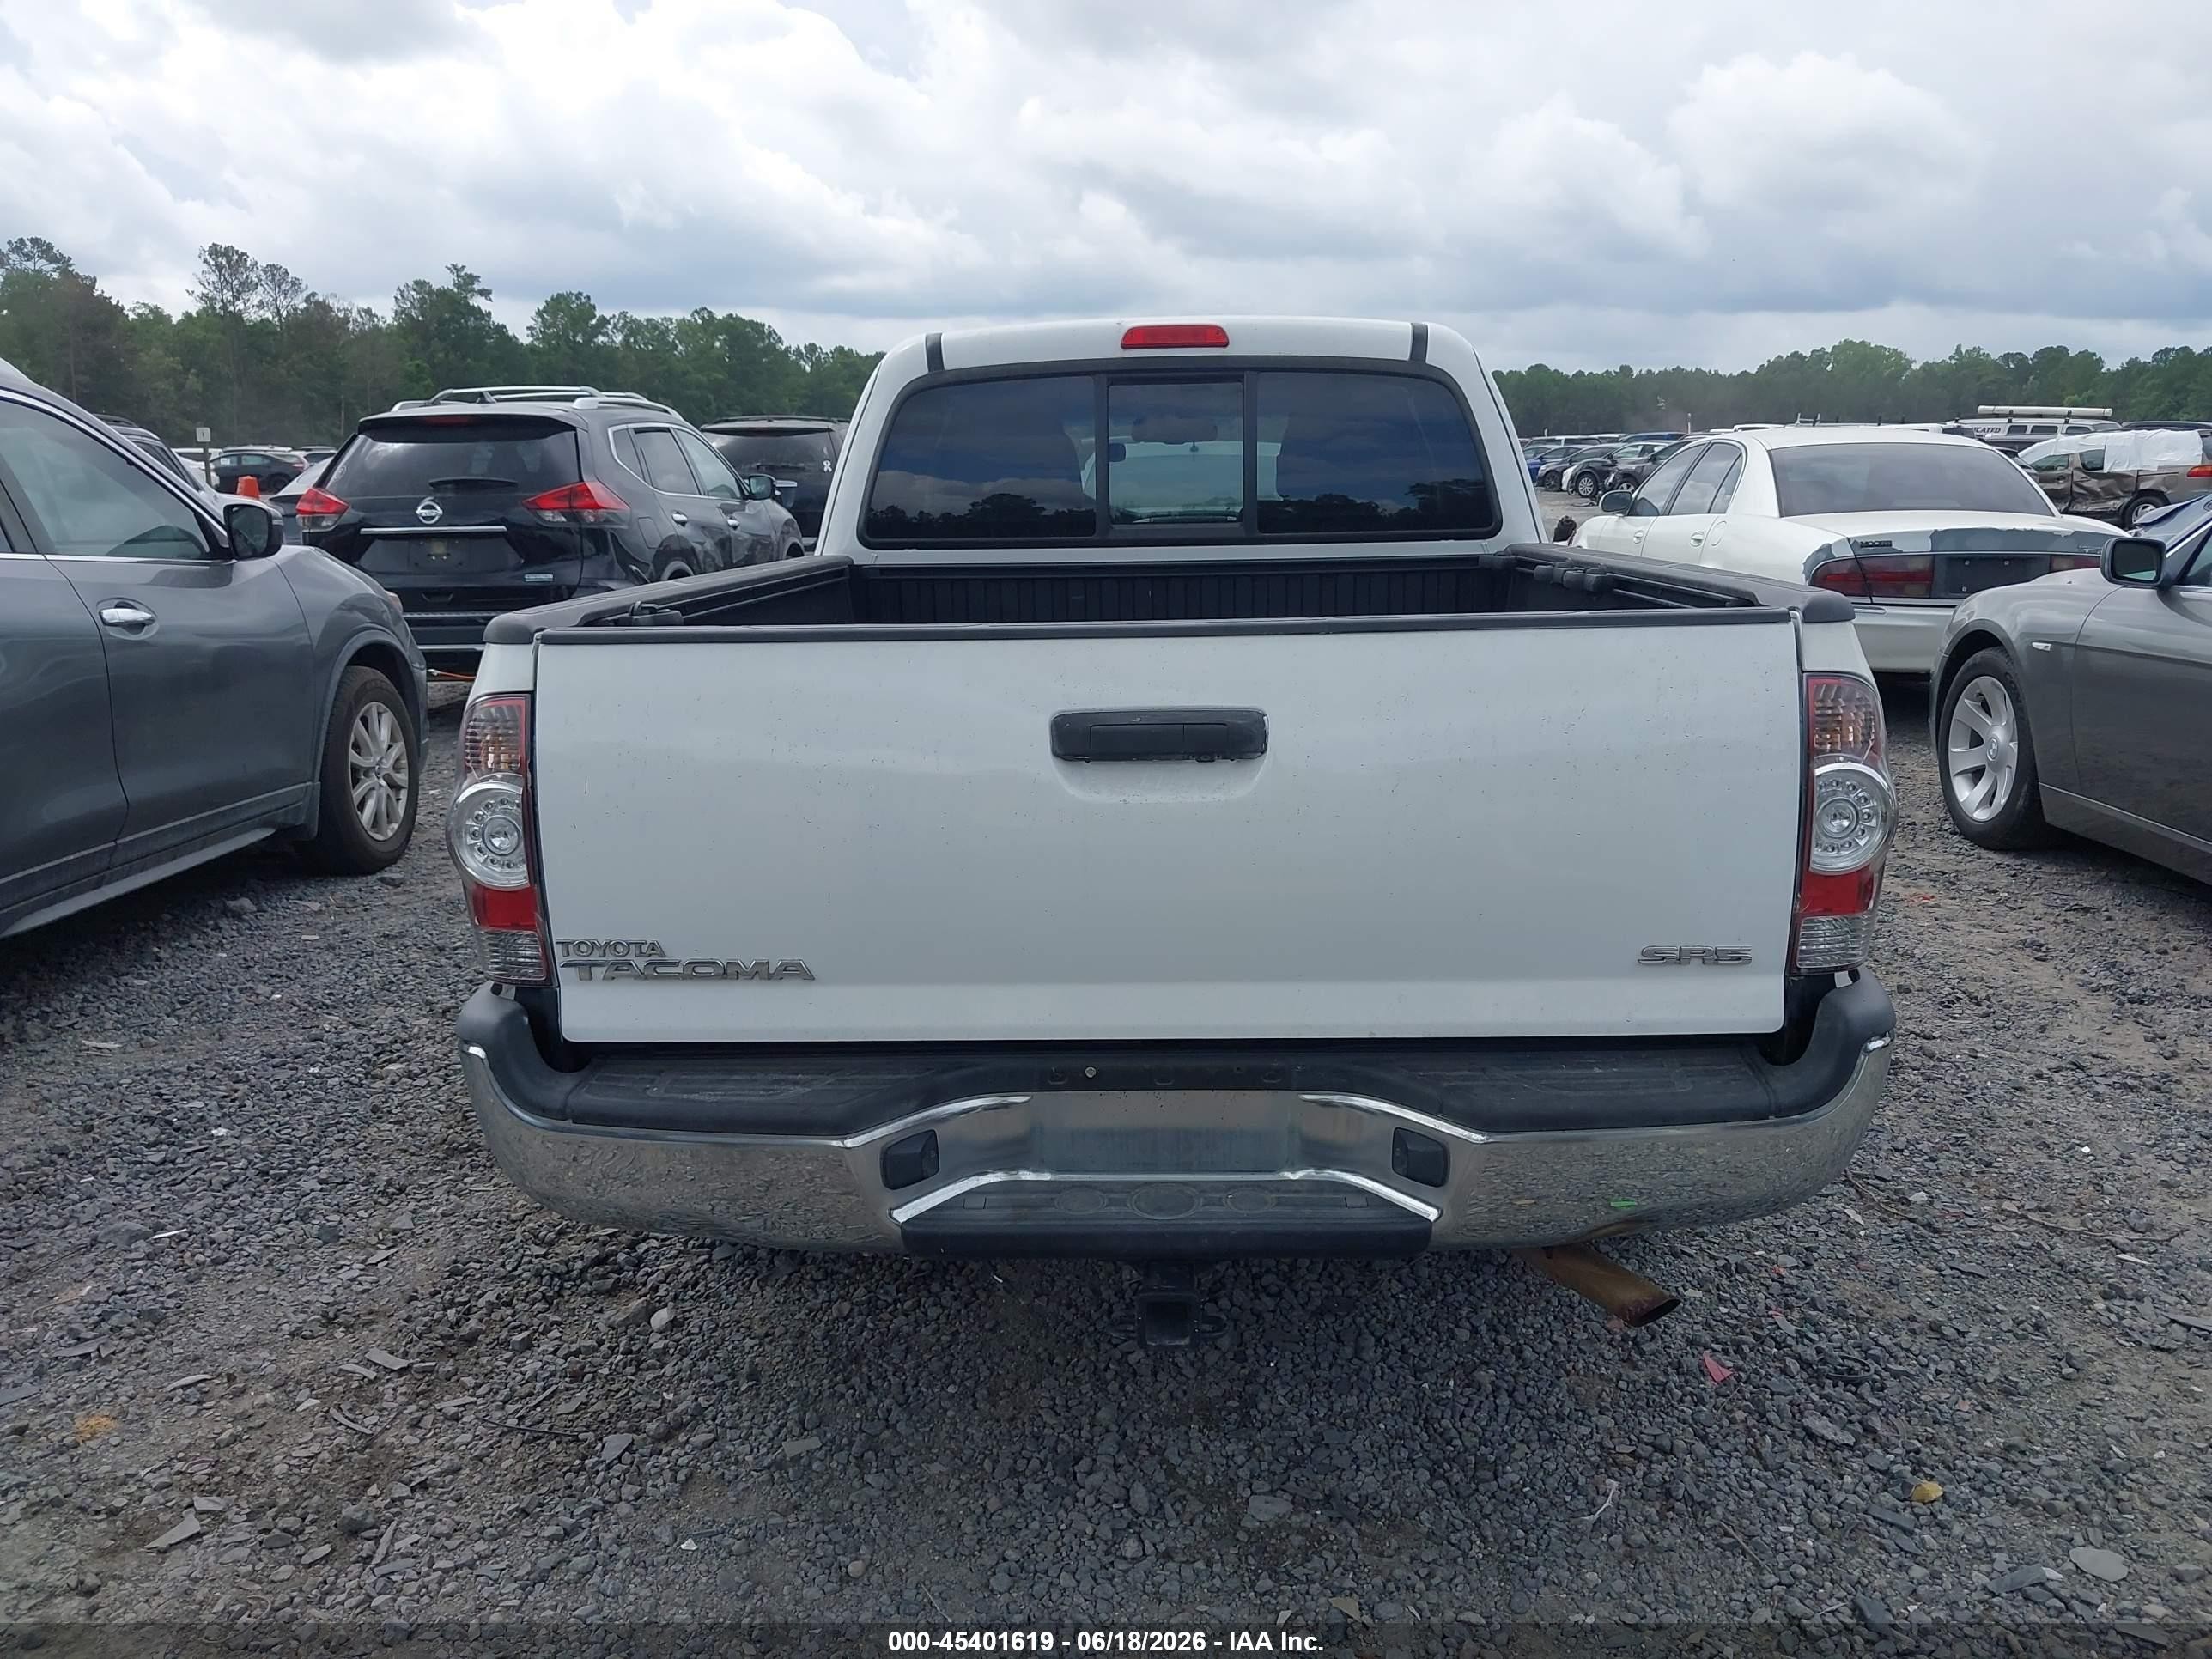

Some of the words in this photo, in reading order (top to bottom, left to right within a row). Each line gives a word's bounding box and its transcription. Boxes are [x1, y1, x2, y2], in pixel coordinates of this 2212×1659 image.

[556, 939, 666, 958] TOYOTA
[1638, 945, 1753, 965] SR5
[560, 959, 815, 981] TACOMA
